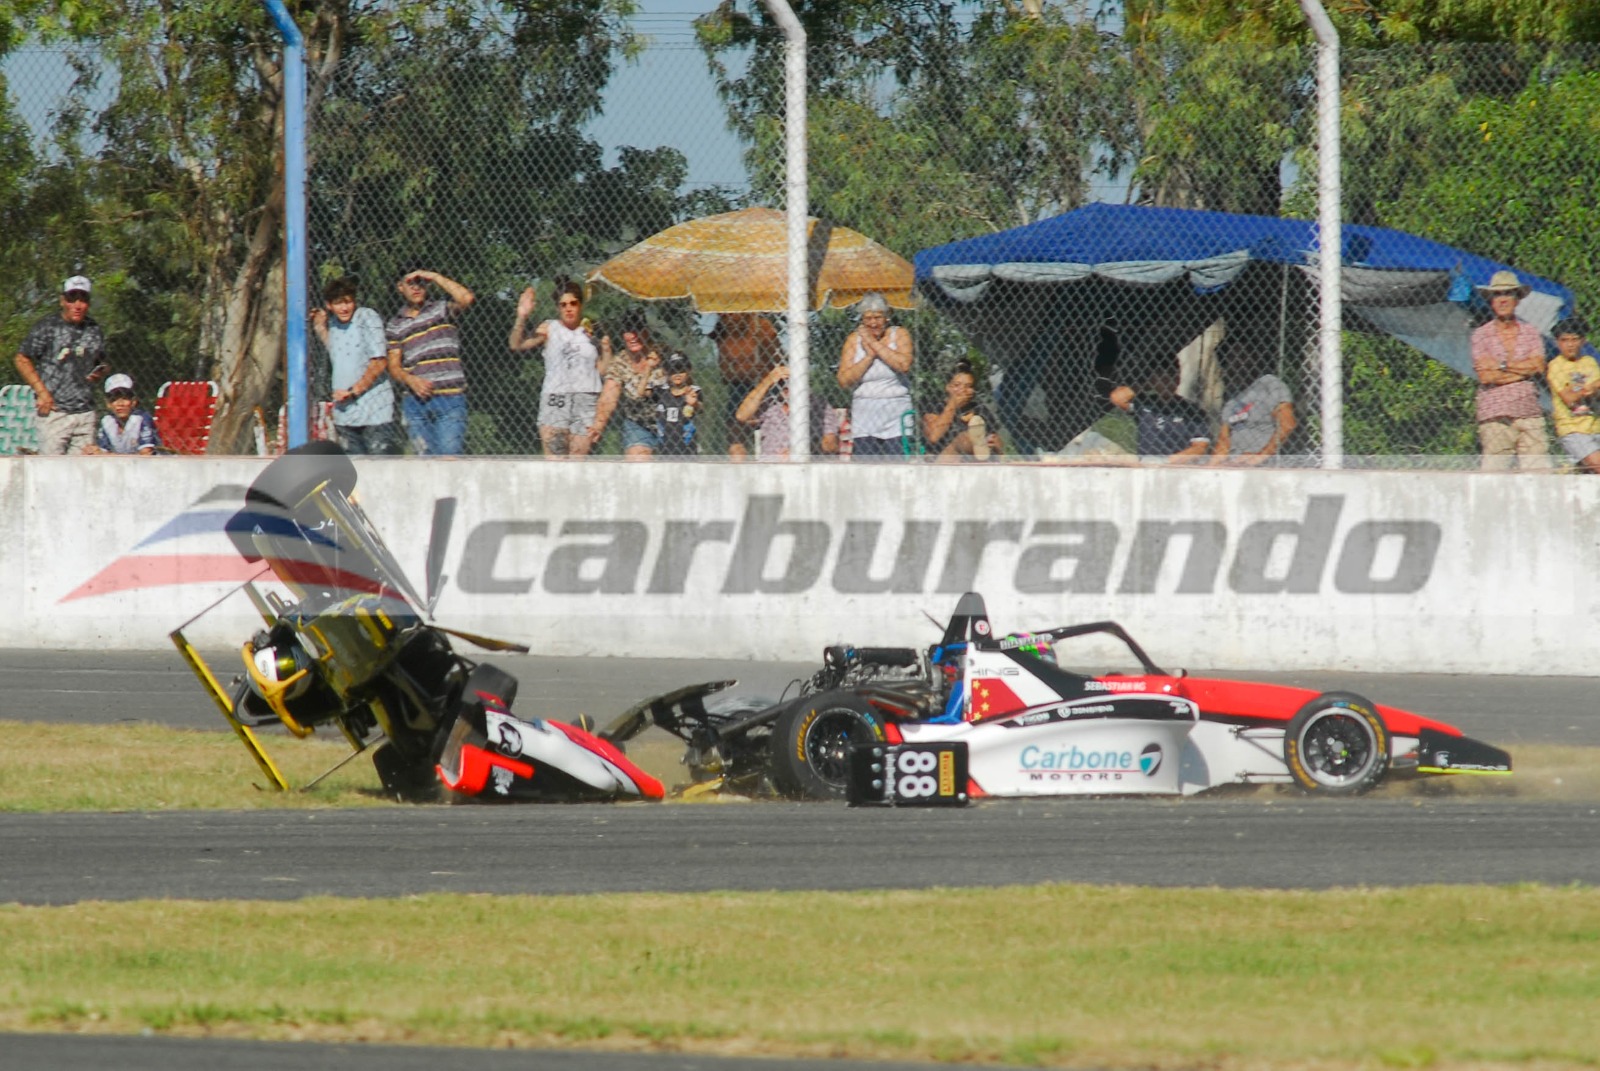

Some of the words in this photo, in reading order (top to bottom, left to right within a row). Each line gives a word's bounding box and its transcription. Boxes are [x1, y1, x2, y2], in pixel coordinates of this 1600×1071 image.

[1020, 744, 1132, 769] Carbone
[898, 751, 937, 798] 88
[1030, 773, 1122, 781] MOTORS
